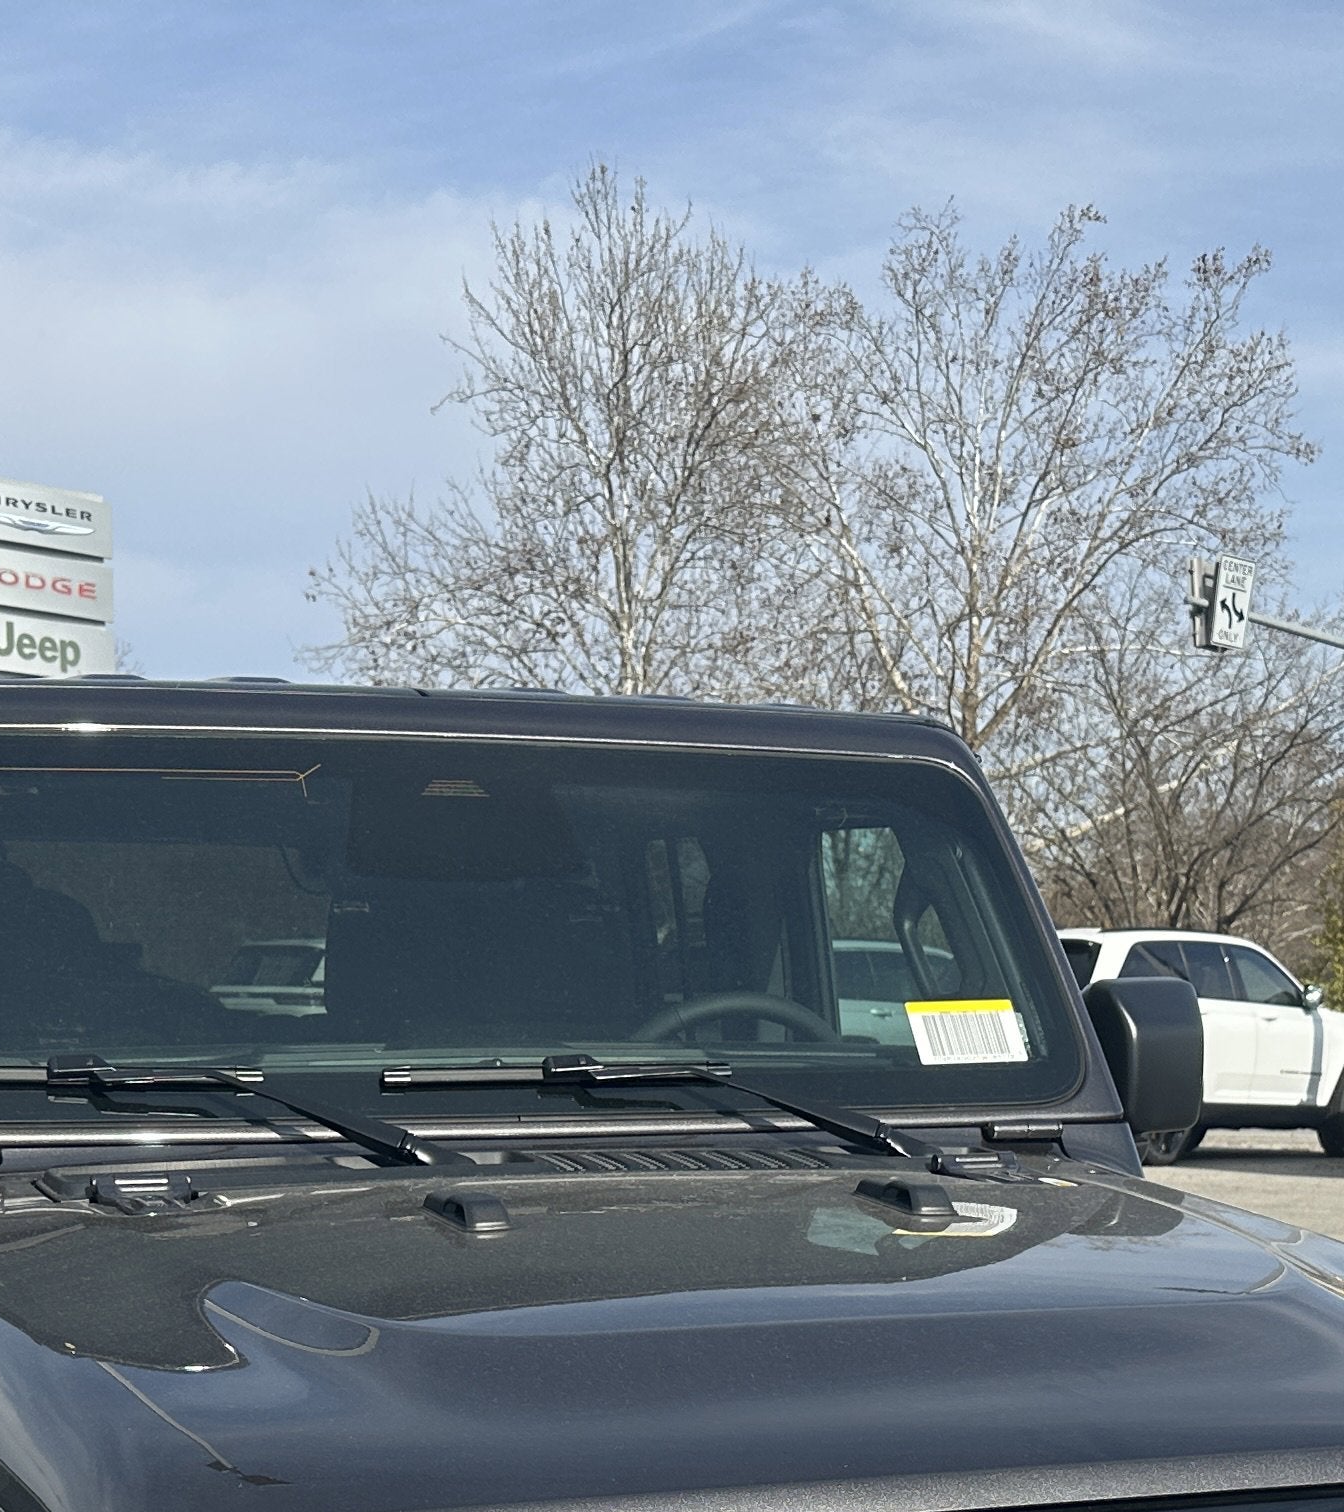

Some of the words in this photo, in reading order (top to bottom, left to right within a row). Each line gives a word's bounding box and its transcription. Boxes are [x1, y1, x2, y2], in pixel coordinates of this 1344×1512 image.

[1223, 560, 1253, 576] CENTER
[1225, 573, 1247, 588] LANE
[1218, 628, 1239, 642] ONLY
